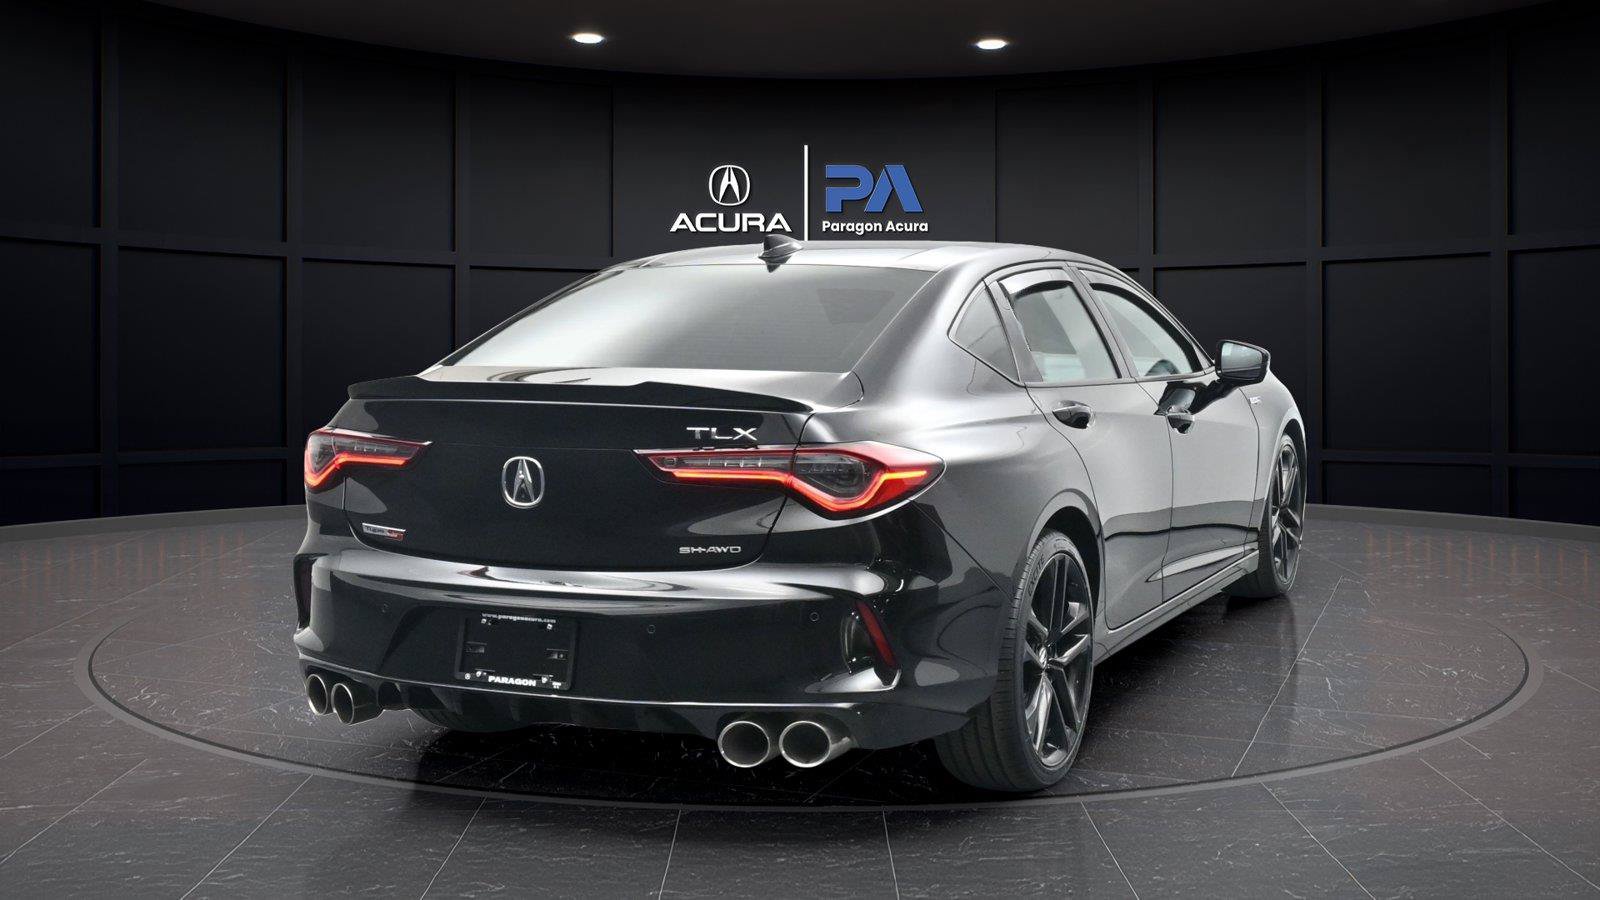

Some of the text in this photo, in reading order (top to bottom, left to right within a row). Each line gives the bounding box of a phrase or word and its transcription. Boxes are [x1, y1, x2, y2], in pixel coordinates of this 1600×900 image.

[825, 164, 924, 213] PA
[669, 212, 792, 233] ACURA
[822, 220, 929, 235] Paragon Acura
[686, 427, 758, 441] TLX
[679, 546, 742, 554] SH-AWD
[487, 675, 537, 687] PARAGON
